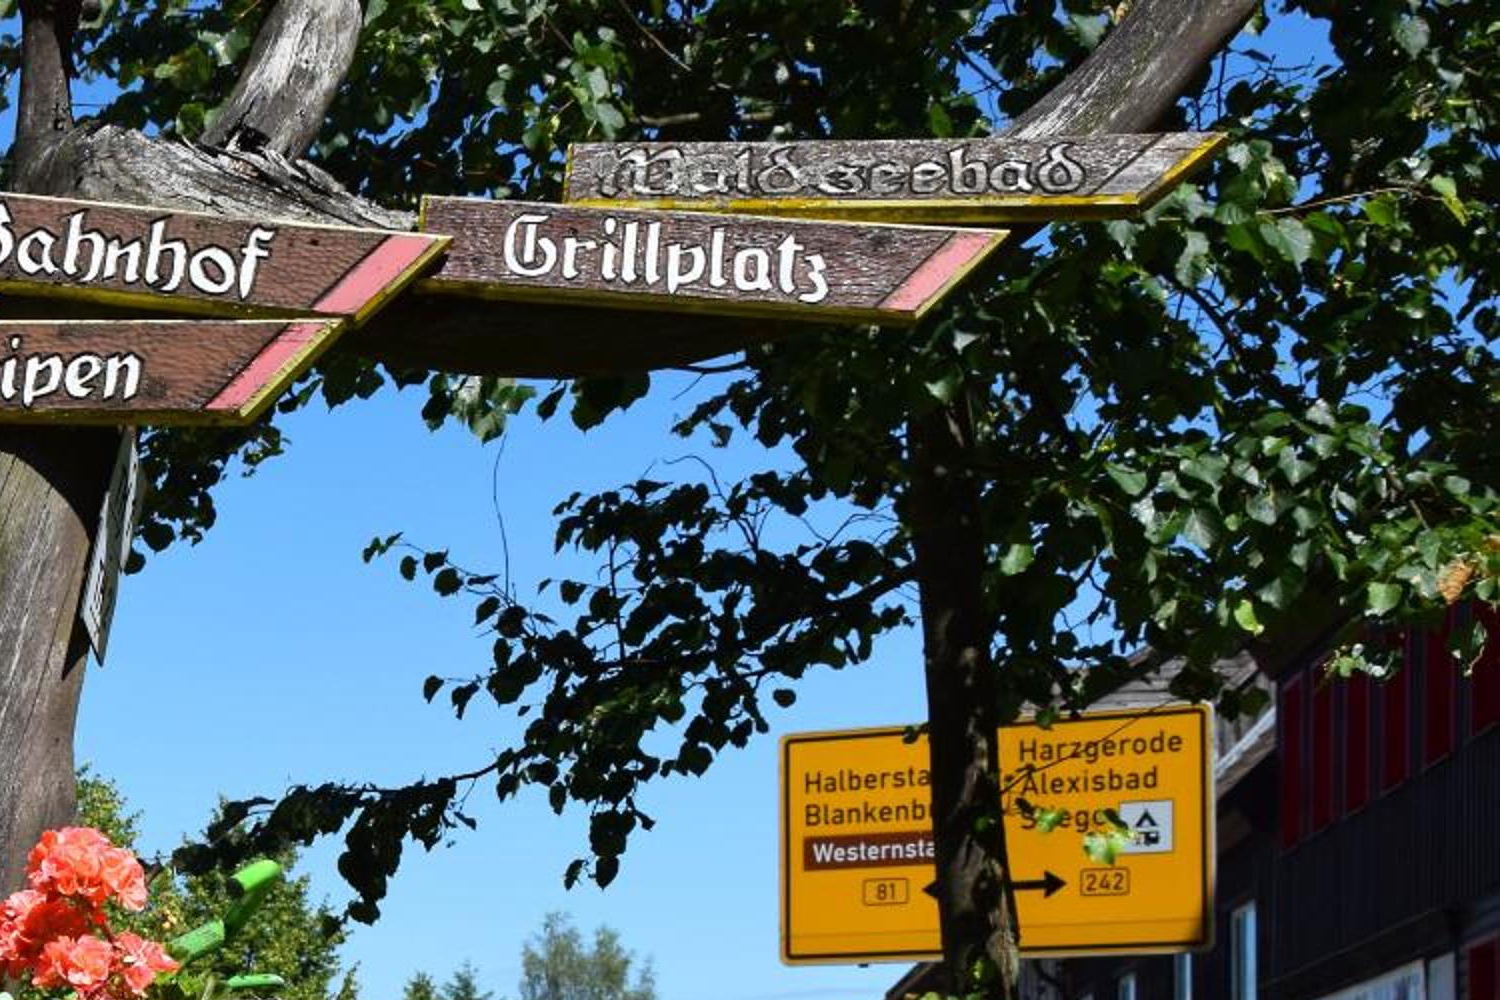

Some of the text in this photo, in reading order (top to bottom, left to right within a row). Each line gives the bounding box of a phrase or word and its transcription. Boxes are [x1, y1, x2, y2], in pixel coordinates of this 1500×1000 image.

[502, 213, 830, 304] Grillplatz
[1019, 730, 1183, 764] Harzgerode
[804, 767, 932, 794] Halbersta
[1020, 765, 1158, 796] Alexisbad
[804, 799, 933, 827] Blankenb
[812, 838, 936, 864] Westernsta
[876, 883, 897, 901] 81
[1085, 871, 1125, 892] 242
